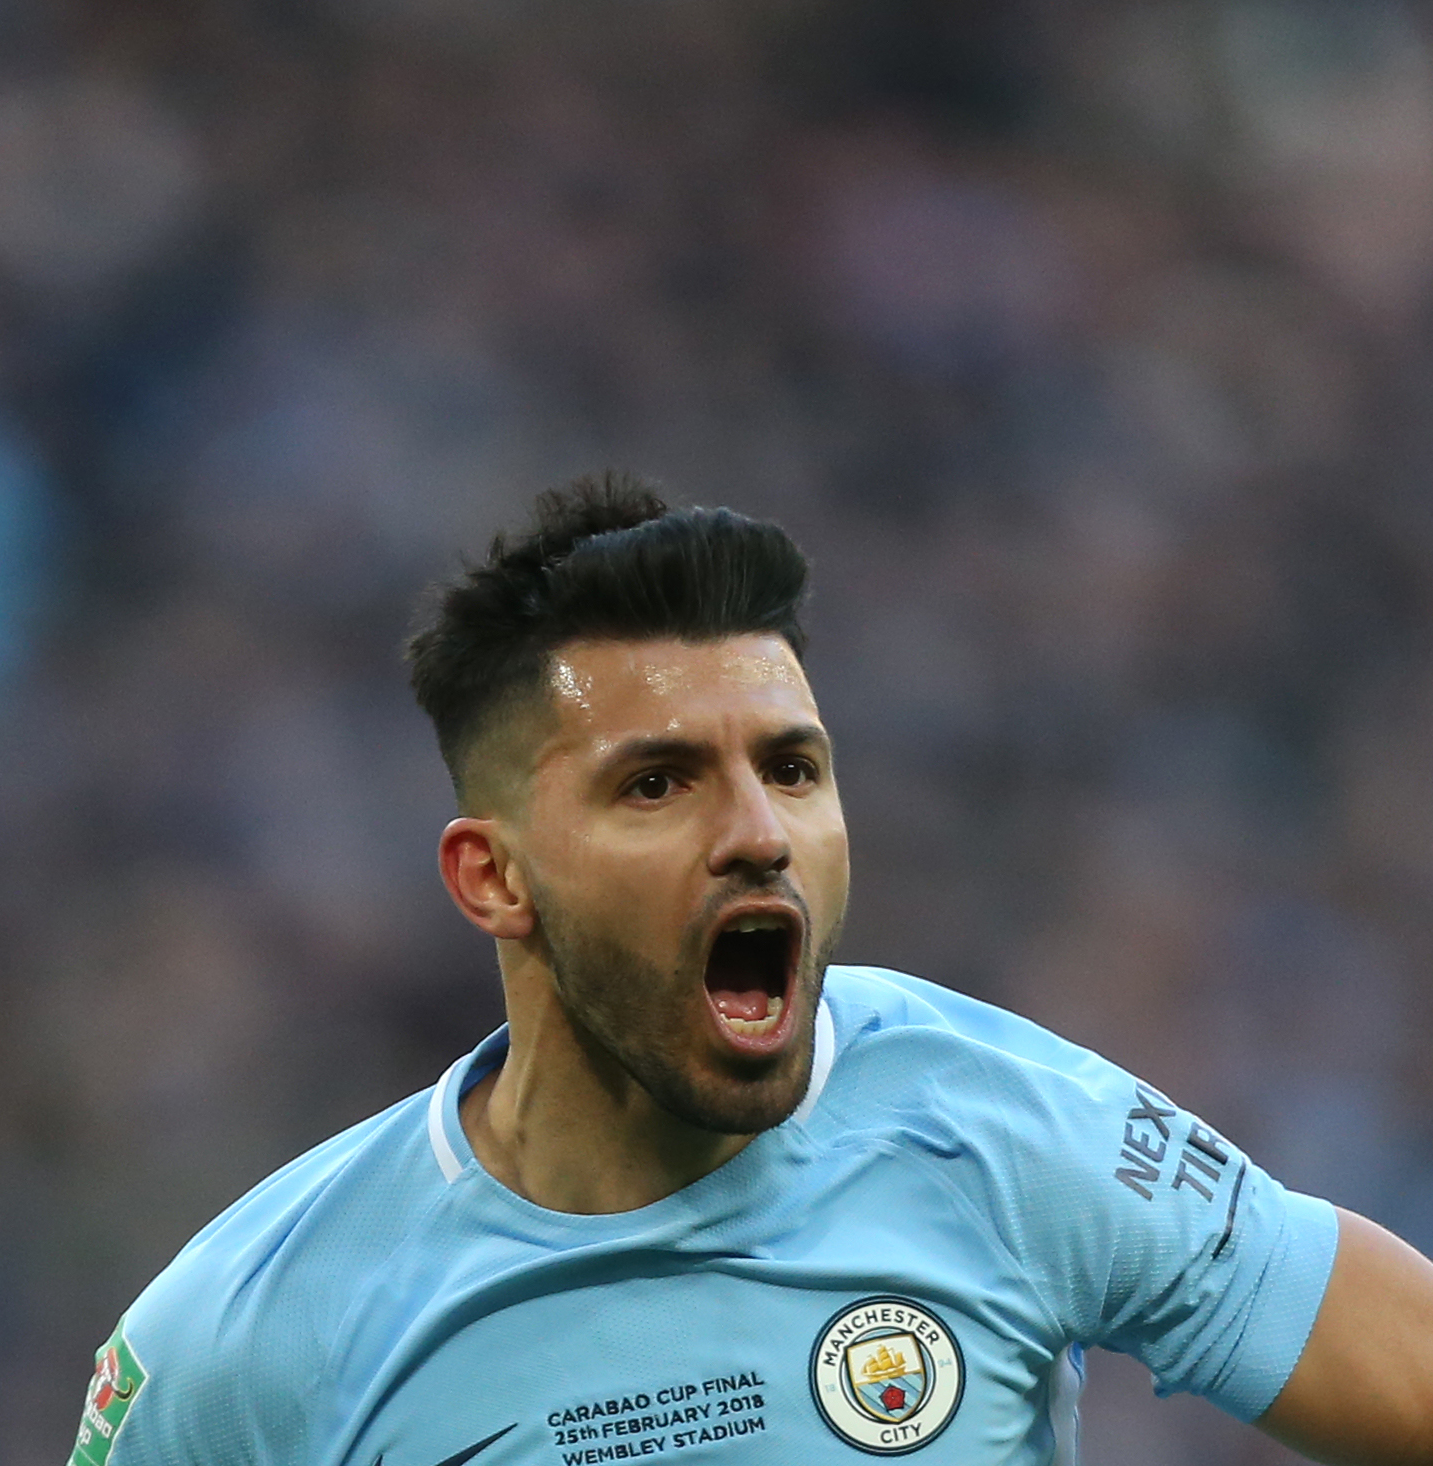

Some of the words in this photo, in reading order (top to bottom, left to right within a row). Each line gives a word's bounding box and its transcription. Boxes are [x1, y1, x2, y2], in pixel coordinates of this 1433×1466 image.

[1115, 1082, 1176, 1203] NEX
[823, 1308, 940, 1366] MANCHESTER
[547, 1394, 650, 1427] CARABAO
[656, 1384, 697, 1406] CUP
[702, 1371, 765, 1396] FINAL
[555, 1424, 598, 1445] 25th
[602, 1403, 711, 1439] FEBRUARY
[717, 1394, 765, 1416] 2018
[562, 1437, 666, 1466] WEMBLEY
[673, 1416, 765, 1449] STADIUM
[880, 1422, 922, 1444] CITY
